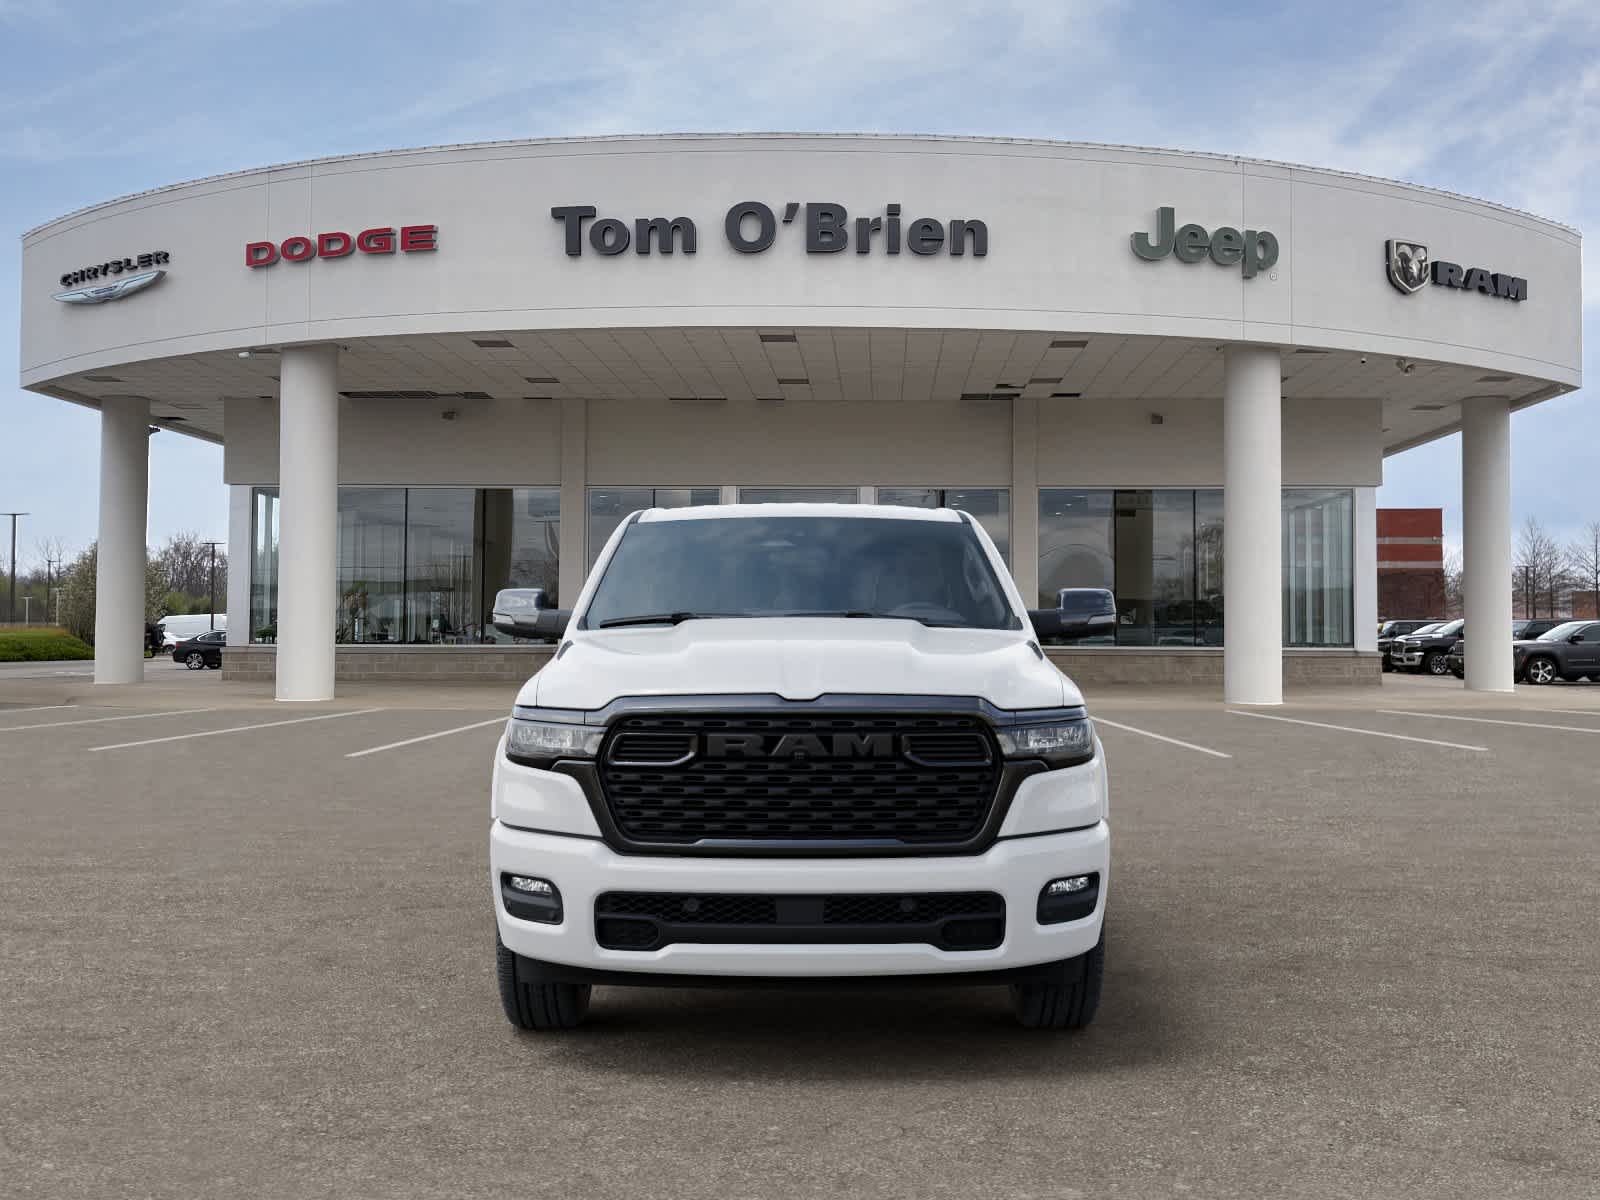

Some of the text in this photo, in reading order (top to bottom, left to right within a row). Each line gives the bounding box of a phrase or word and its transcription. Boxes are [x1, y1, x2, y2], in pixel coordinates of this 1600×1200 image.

[245, 224, 437, 268] DODGE
[551, 201, 988, 256] Tom O'Brien
[1130, 206, 1279, 279] Jeep
[60, 250, 170, 286] CHRYSLER
[1430, 261, 1528, 302] RAM
[706, 732, 895, 757] RAM
